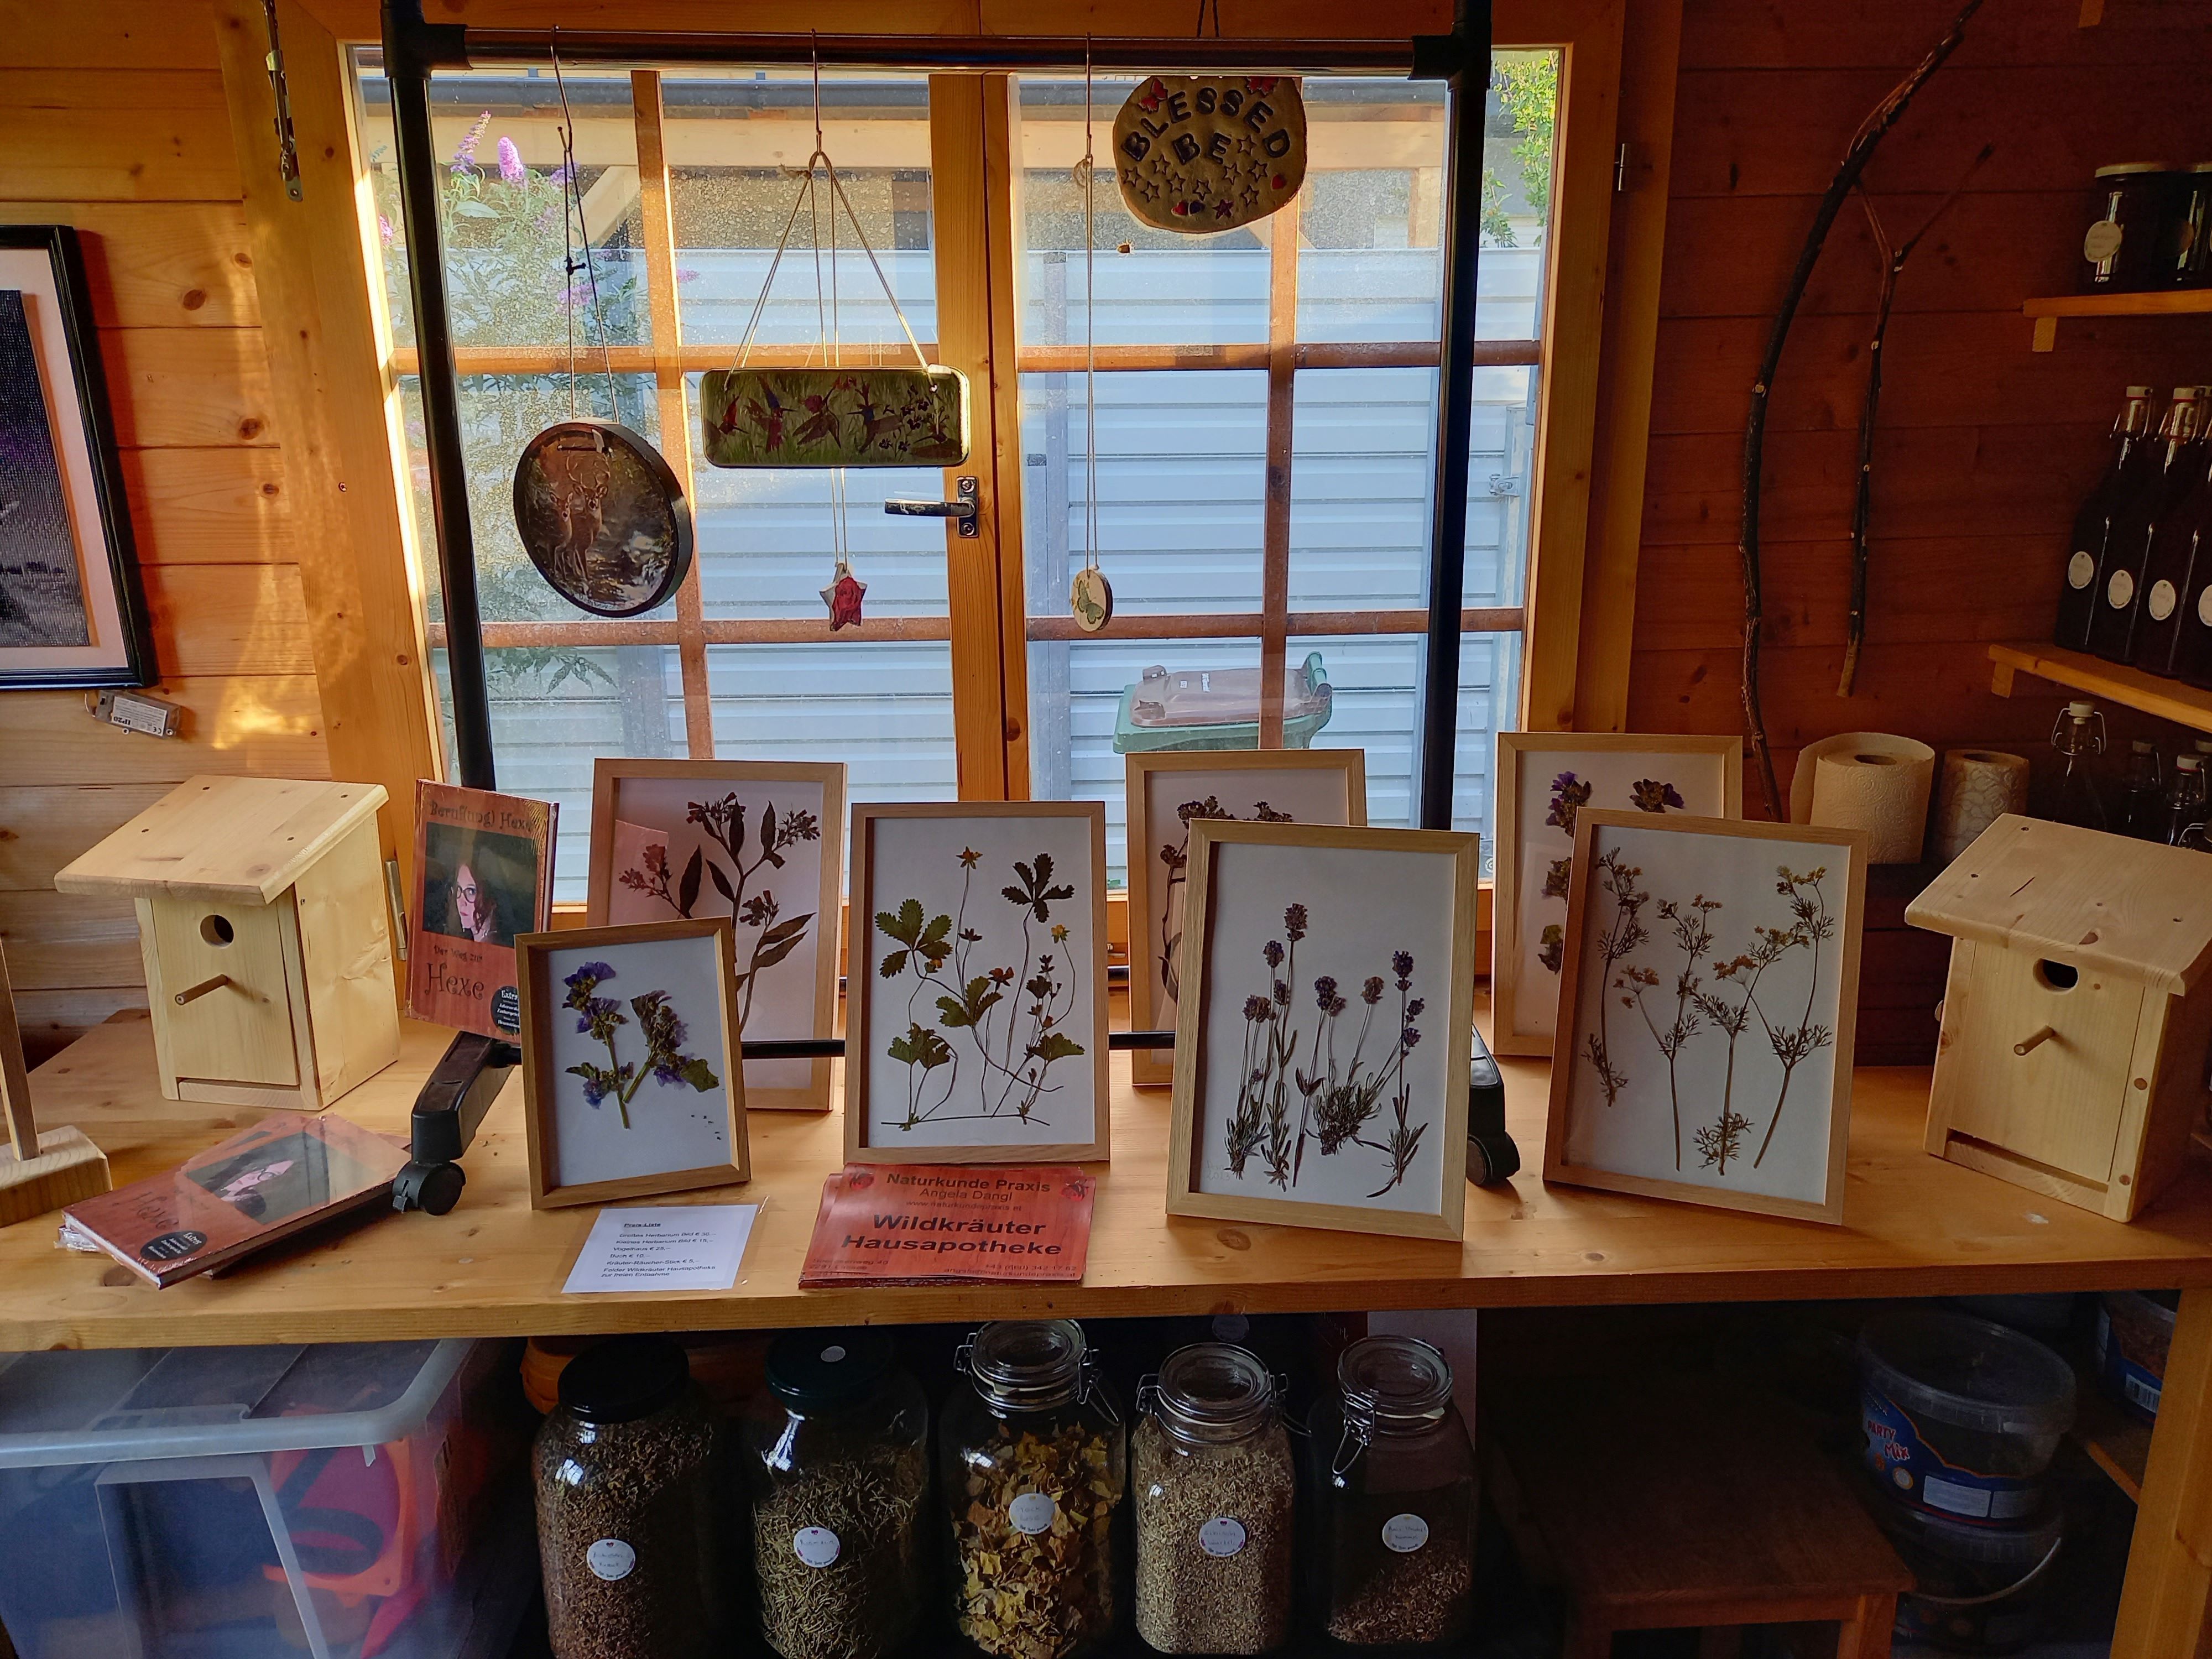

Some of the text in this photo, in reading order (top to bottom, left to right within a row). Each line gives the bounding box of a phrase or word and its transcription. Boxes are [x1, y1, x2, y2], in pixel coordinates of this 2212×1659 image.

[1121, 87, 1290, 161] BLESSED
[1172, 132, 1232, 165] BE
[113, 716, 131, 726] IP20
[424, 962, 484, 1000] Hexe
[886, 1173, 1051, 1192] Naturkunde Praxis
[919, 1188, 1013, 1202] Angela Dangl
[873, 1214, 1046, 1235] Wildkräuter
[841, 1234, 1062, 1255] Hausapotheke
[1867, 1420, 1897, 1441] PARTY
